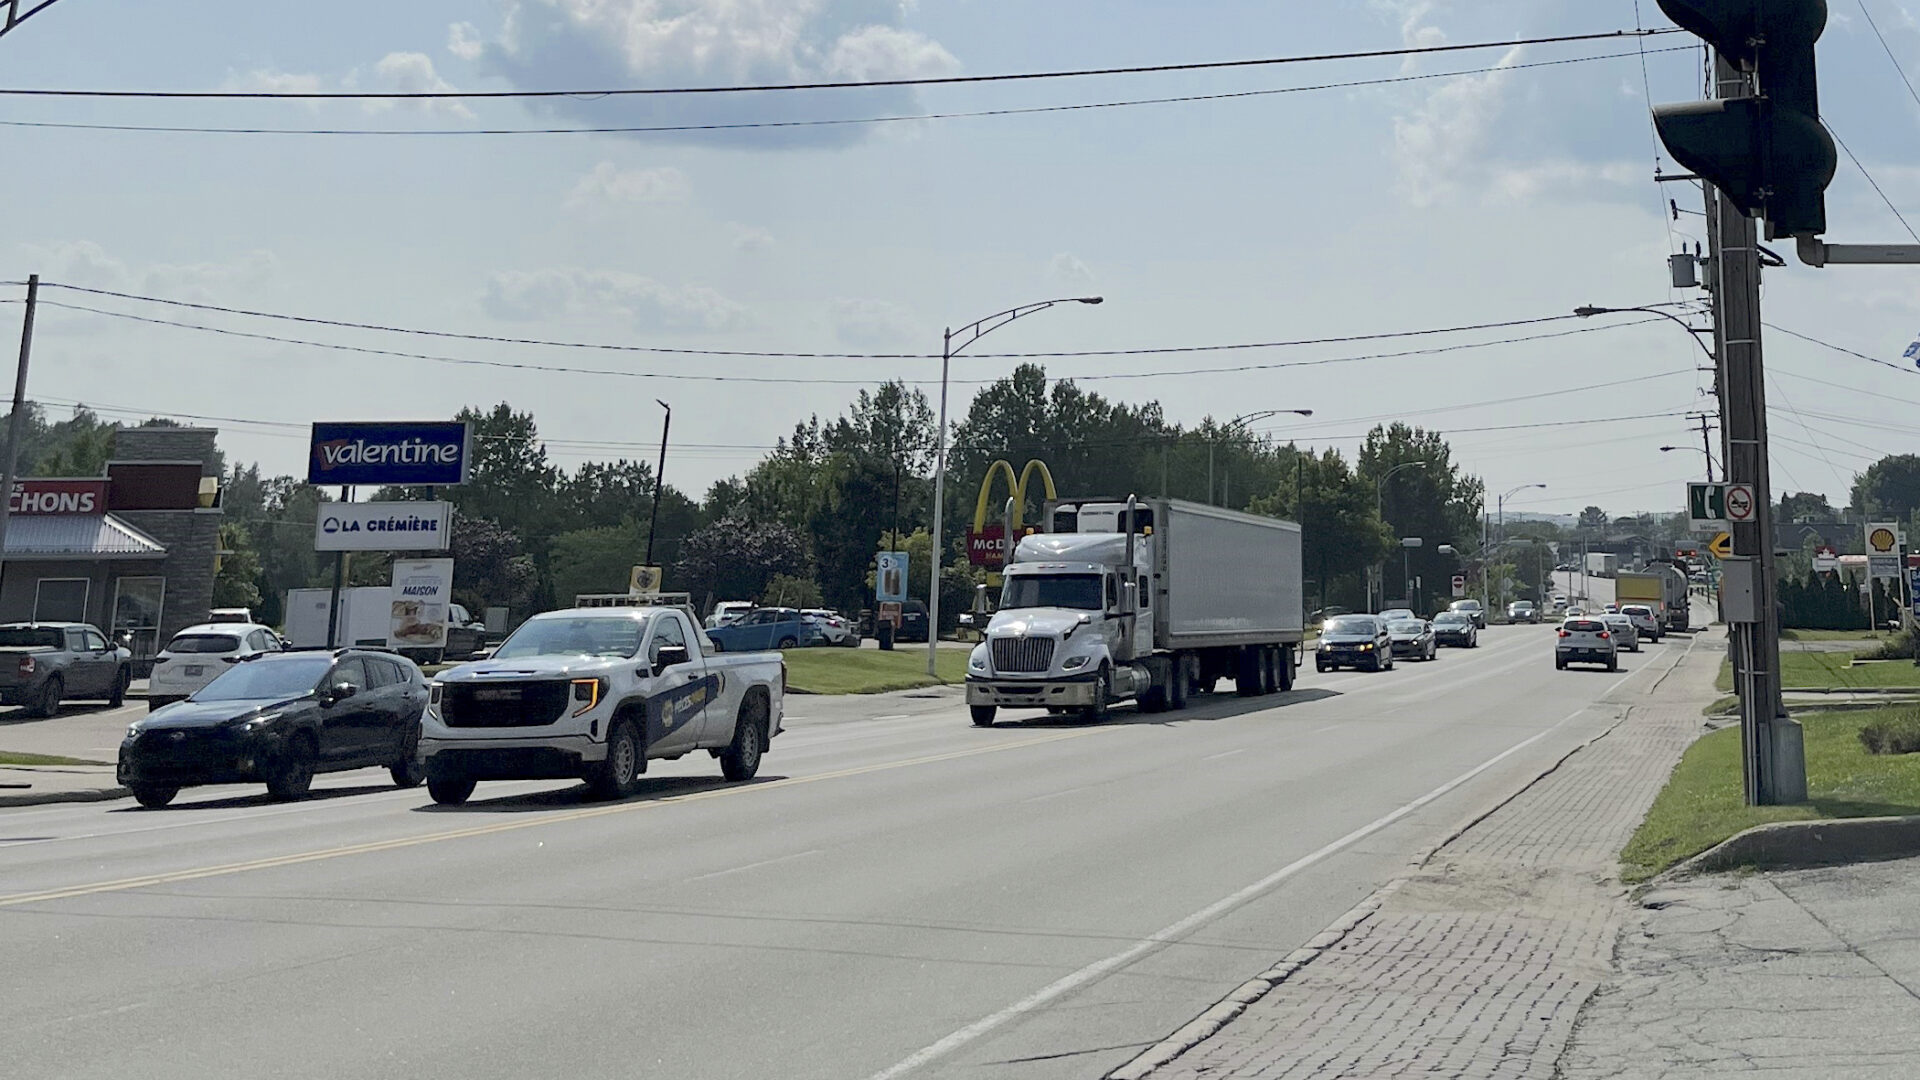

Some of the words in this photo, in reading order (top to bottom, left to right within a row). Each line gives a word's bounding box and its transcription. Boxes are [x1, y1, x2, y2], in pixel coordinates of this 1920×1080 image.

[342, 519, 360, 532] LA
[367, 514, 438, 532] CRÉMIÈRE
[402, 585, 439, 595] MAISON
